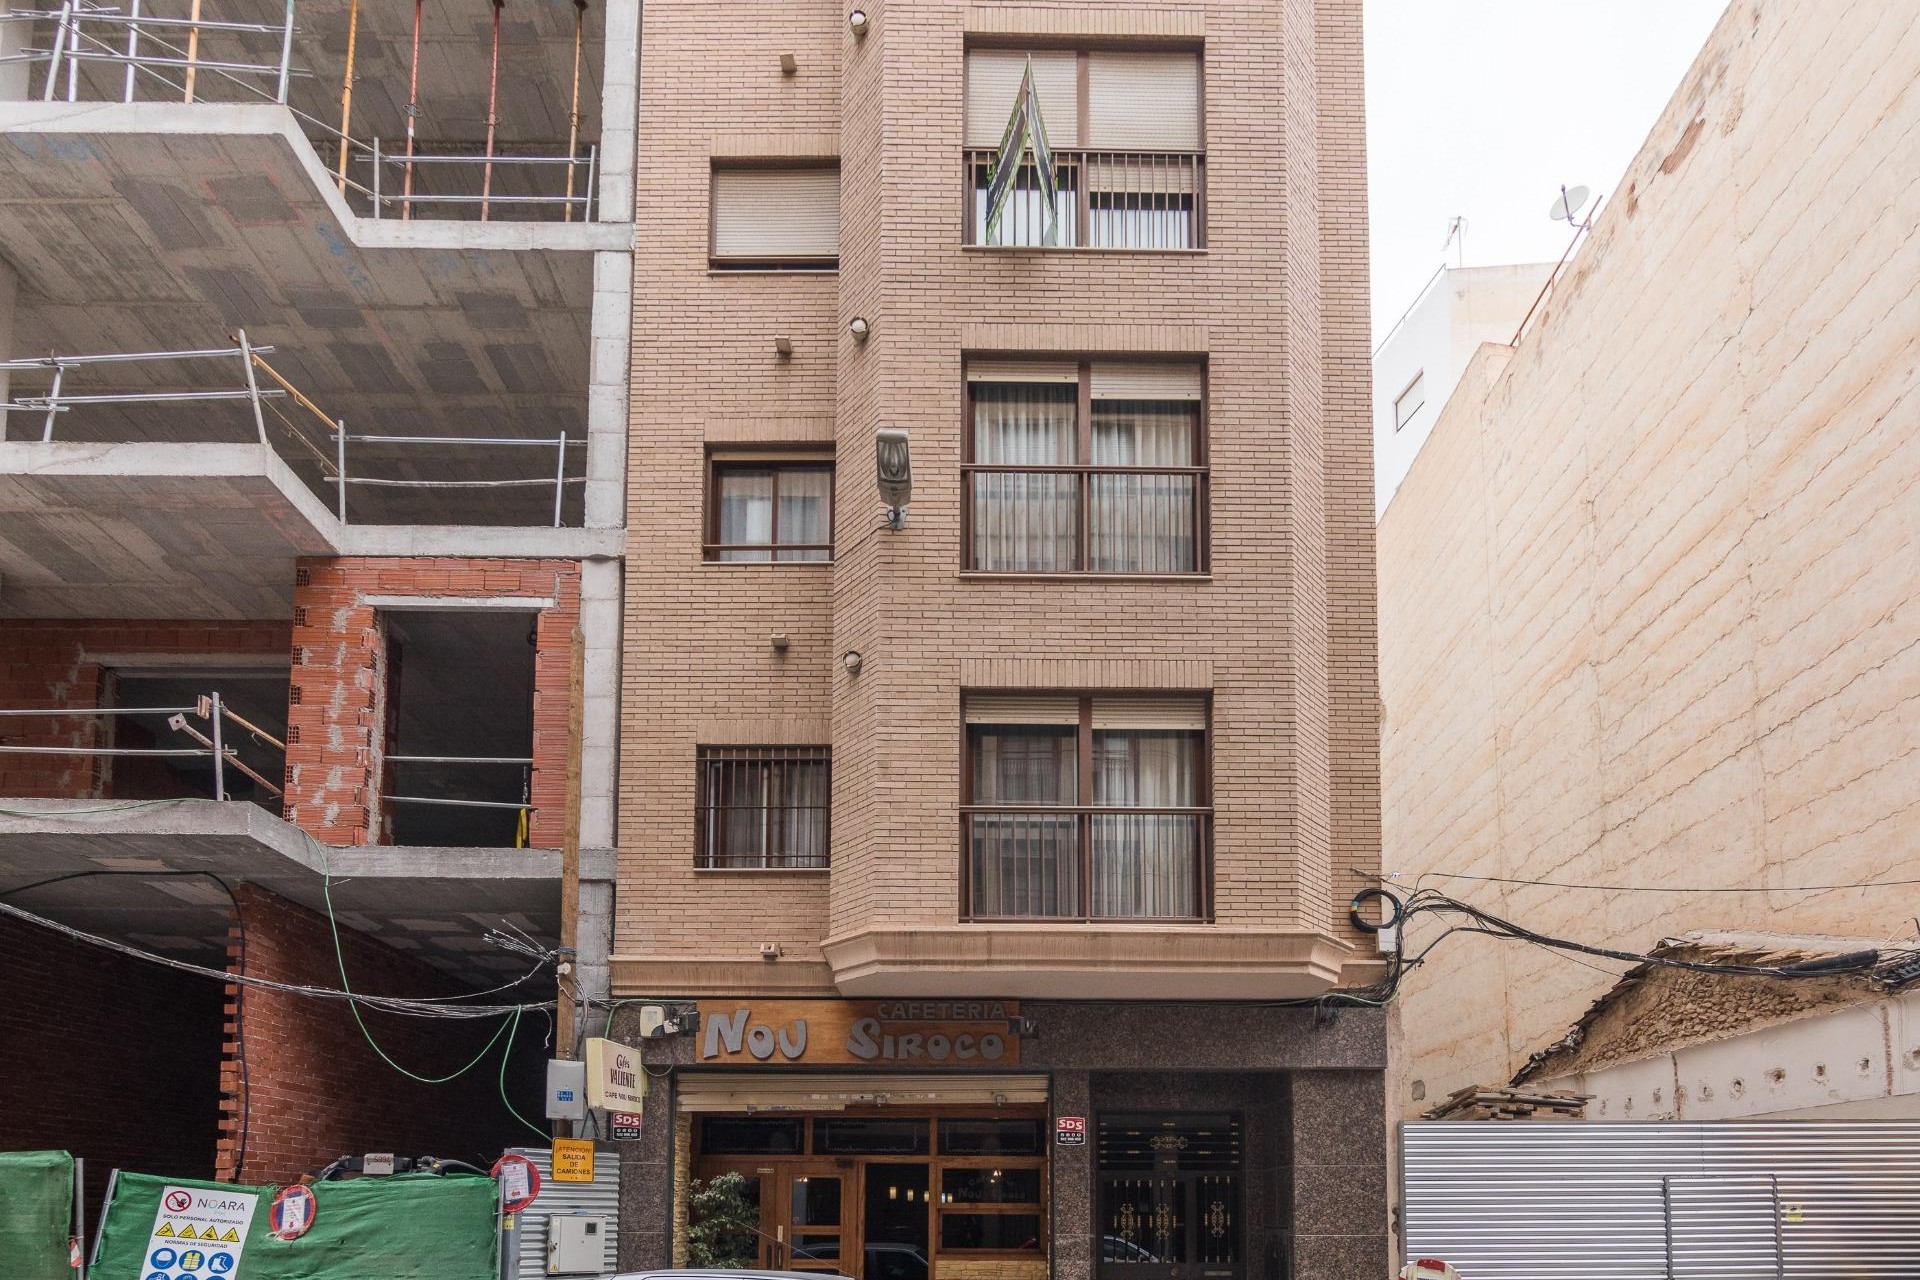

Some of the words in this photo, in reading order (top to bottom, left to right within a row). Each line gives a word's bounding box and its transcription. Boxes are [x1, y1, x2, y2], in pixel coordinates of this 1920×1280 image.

[877, 1002, 1006, 1019] CAFETERIA
[703, 1008, 807, 1060] NOU
[846, 1016, 1004, 1061] SIROCO
[610, 1067, 636, 1089] VALIENTE
[615, 1114, 640, 1126] SDS
[1058, 1119, 1083, 1130] SDS
[562, 1153, 586, 1161] SALIDA
[197, 1198, 246, 1212] NOARA
[209, 1217, 244, 1226] AUTORIZADO
[164, 1239, 190, 1247] NORMAS
